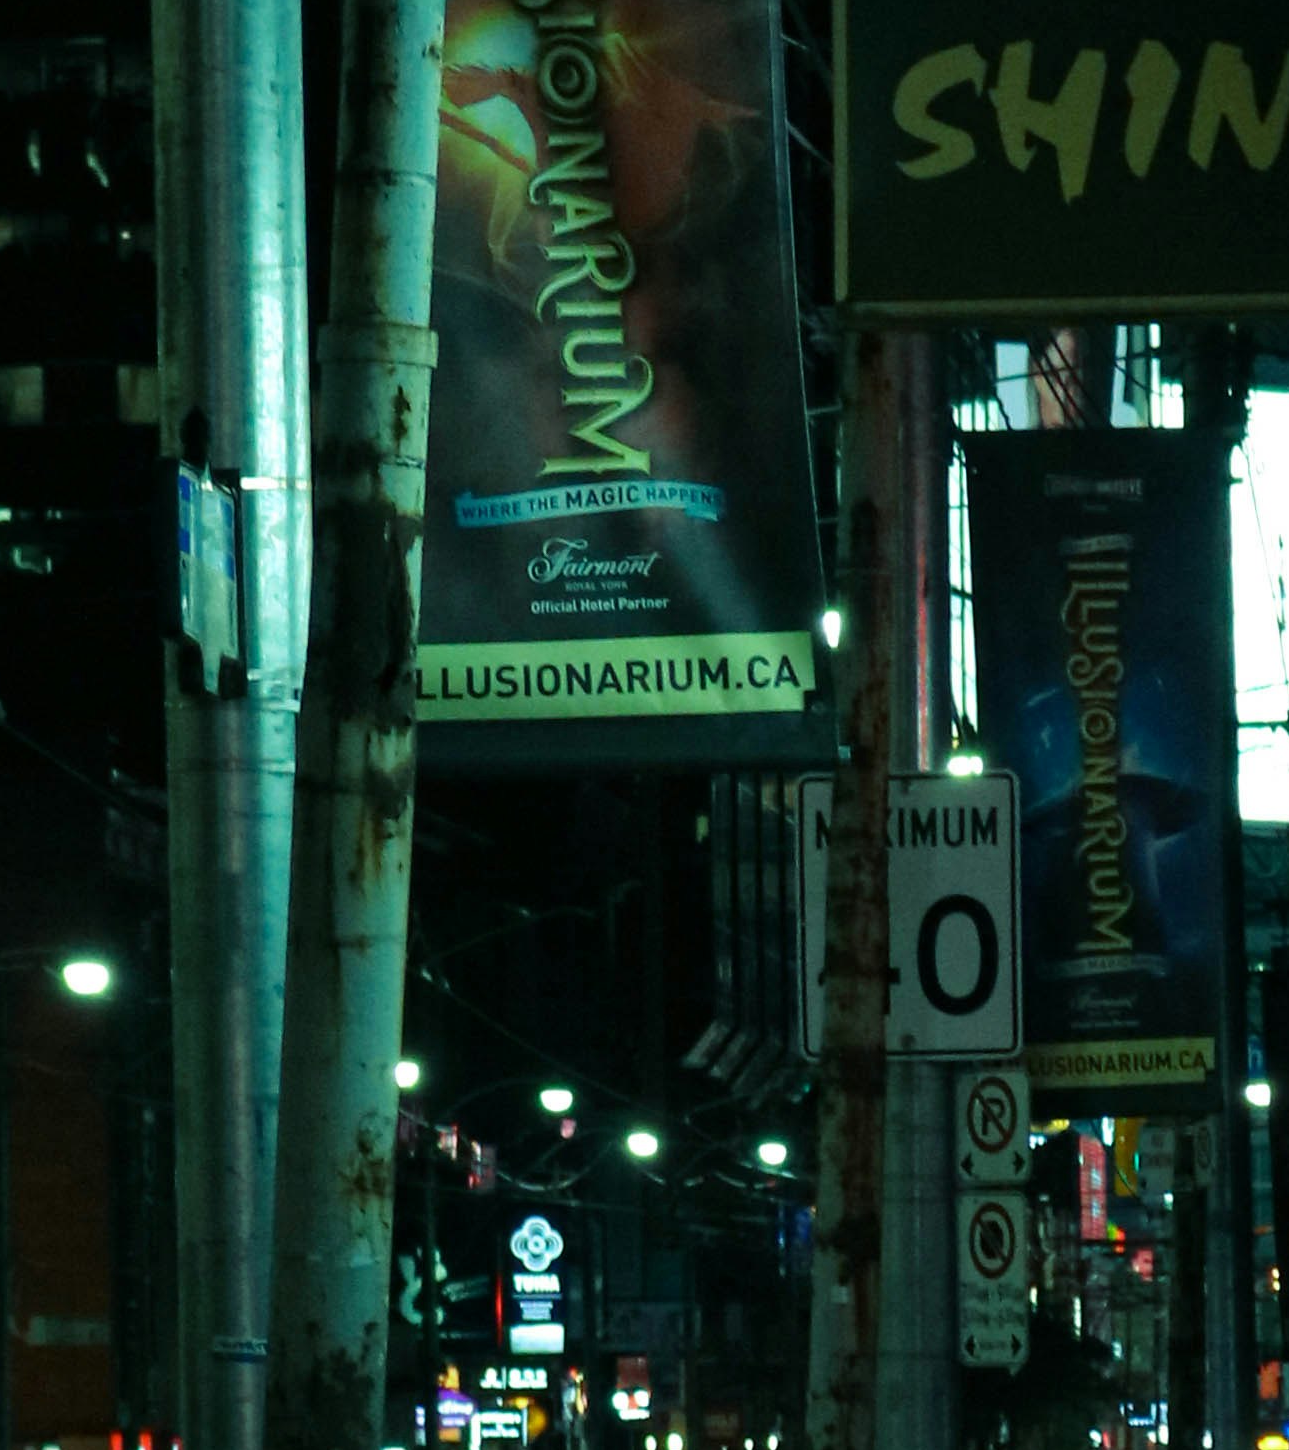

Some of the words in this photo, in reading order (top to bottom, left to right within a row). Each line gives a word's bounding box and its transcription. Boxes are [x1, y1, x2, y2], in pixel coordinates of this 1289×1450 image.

[459, 500, 522, 521] WHERE
[528, 495, 559, 512] THE
[565, 485, 640, 510] MAGIC
[526, 536, 663, 585] Fairmont
[529, 597, 578, 615] Official
[580, 597, 616, 613] Hotel
[619, 595, 671, 612] Partner
[815, 806, 998, 849] MIMUM
